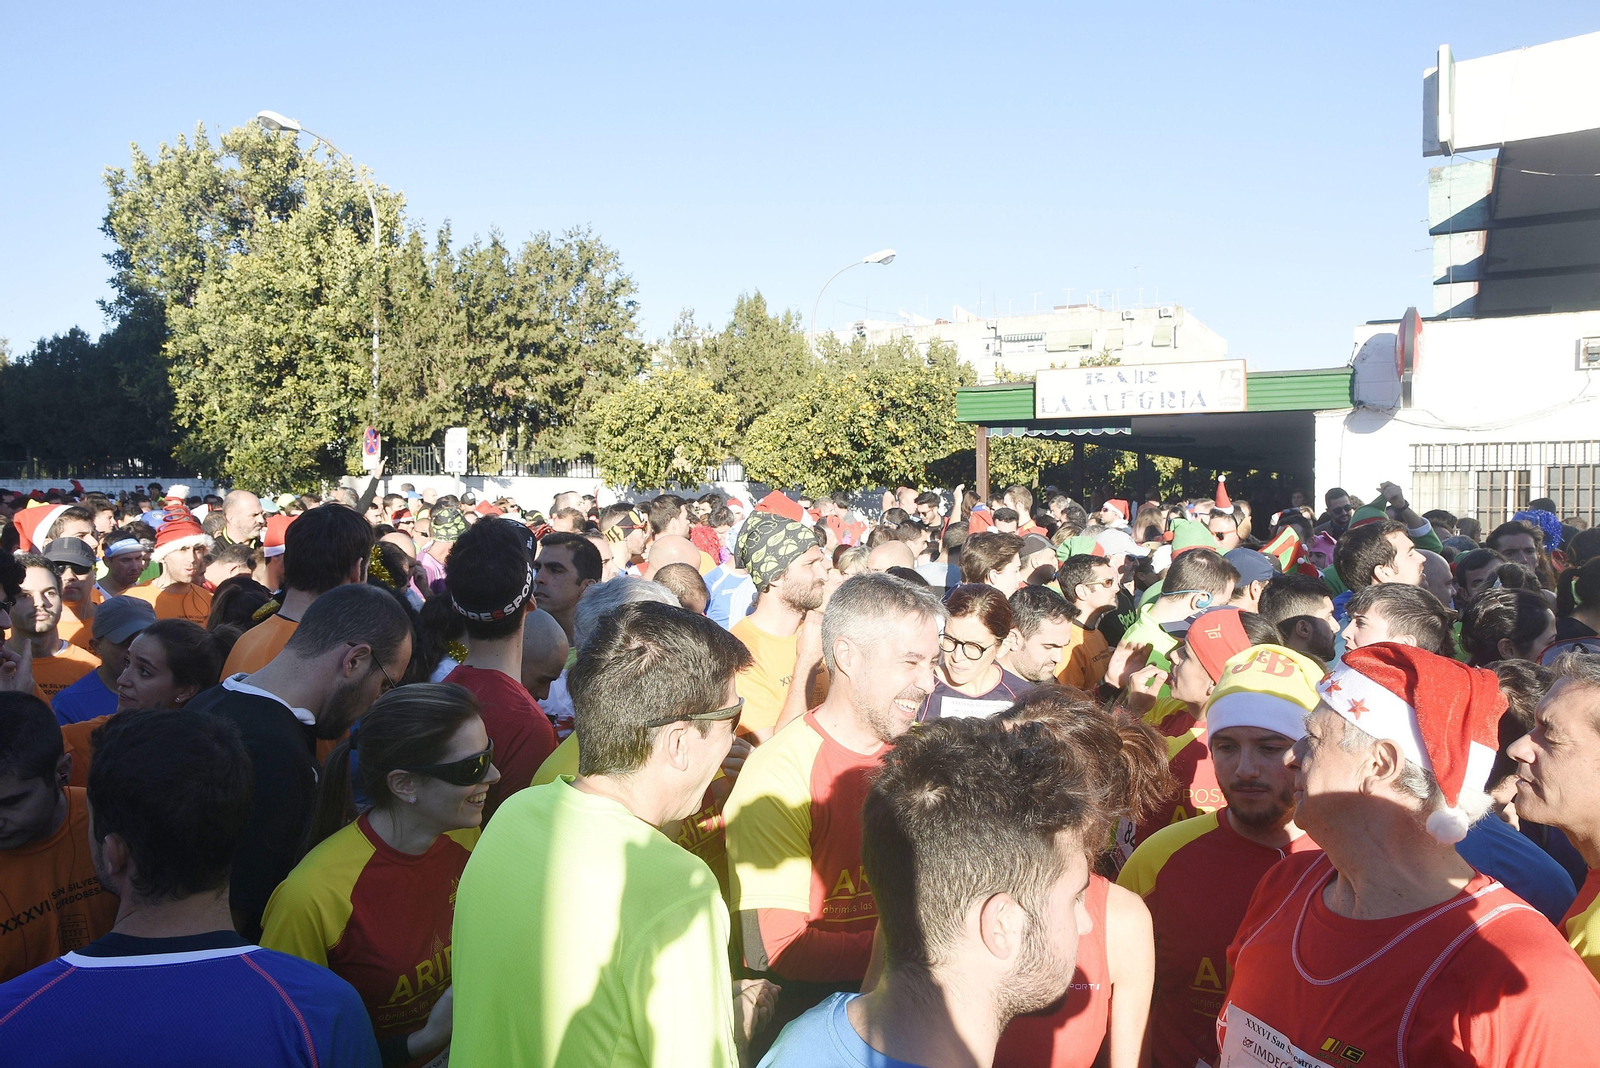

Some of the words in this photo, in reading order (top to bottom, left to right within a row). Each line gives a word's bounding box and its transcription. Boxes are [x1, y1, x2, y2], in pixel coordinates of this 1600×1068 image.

[1041, 396, 1072, 414] LA
[1082, 390, 1207, 412] ALEGRIA
[1231, 650, 1295, 678] J&B
[0, 900, 51, 936] XXXVI
[1245, 1017, 1271, 1040] XXXVI
[1272, 1035, 1286, 1051] San
